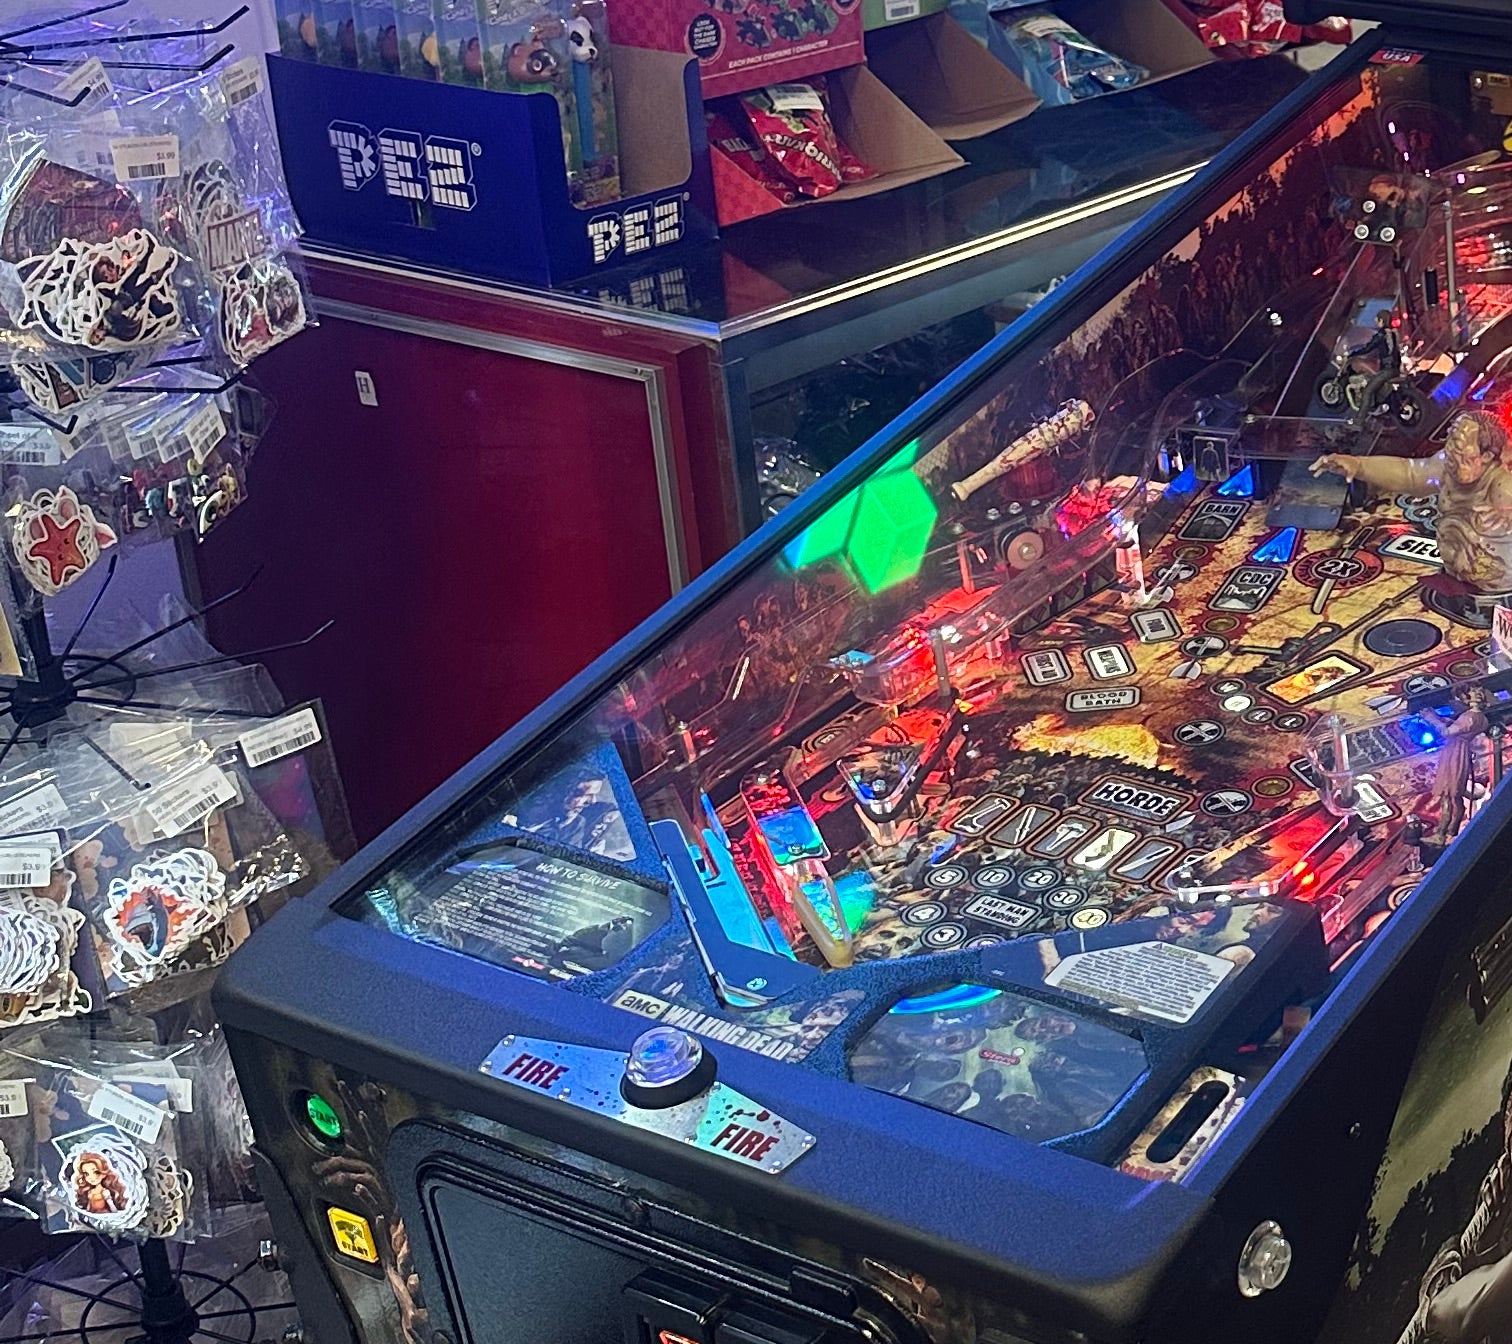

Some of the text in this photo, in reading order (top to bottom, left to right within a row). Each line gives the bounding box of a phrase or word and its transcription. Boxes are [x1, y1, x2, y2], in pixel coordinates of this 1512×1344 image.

[1382, 52, 1412, 63] USA
[329, 120, 478, 212] PEZ
[587, 201, 682, 264] PEZ
[1204, 503, 1240, 514] BARN
[1396, 539, 1441, 558] SIEG
[1318, 559, 1359, 578] 2X
[1239, 571, 1273, 585] CDC
[200, 780, 219, 794] $3.9
[1093, 782, 1181, 817] HORDE
[535, 862, 561, 876] HOW
[562, 866, 577, 879] TO
[982, 870, 1005, 884] 10
[1029, 870, 1053, 885] 20
[1054, 891, 1078, 905] 30
[661, 1005, 794, 1061] WALKING DEAD
[503, 1053, 571, 1093] FIRE
[310, 1108, 338, 1125] START
[709, 1122, 782, 1163] FIRE
[341, 1240, 368, 1257] START
